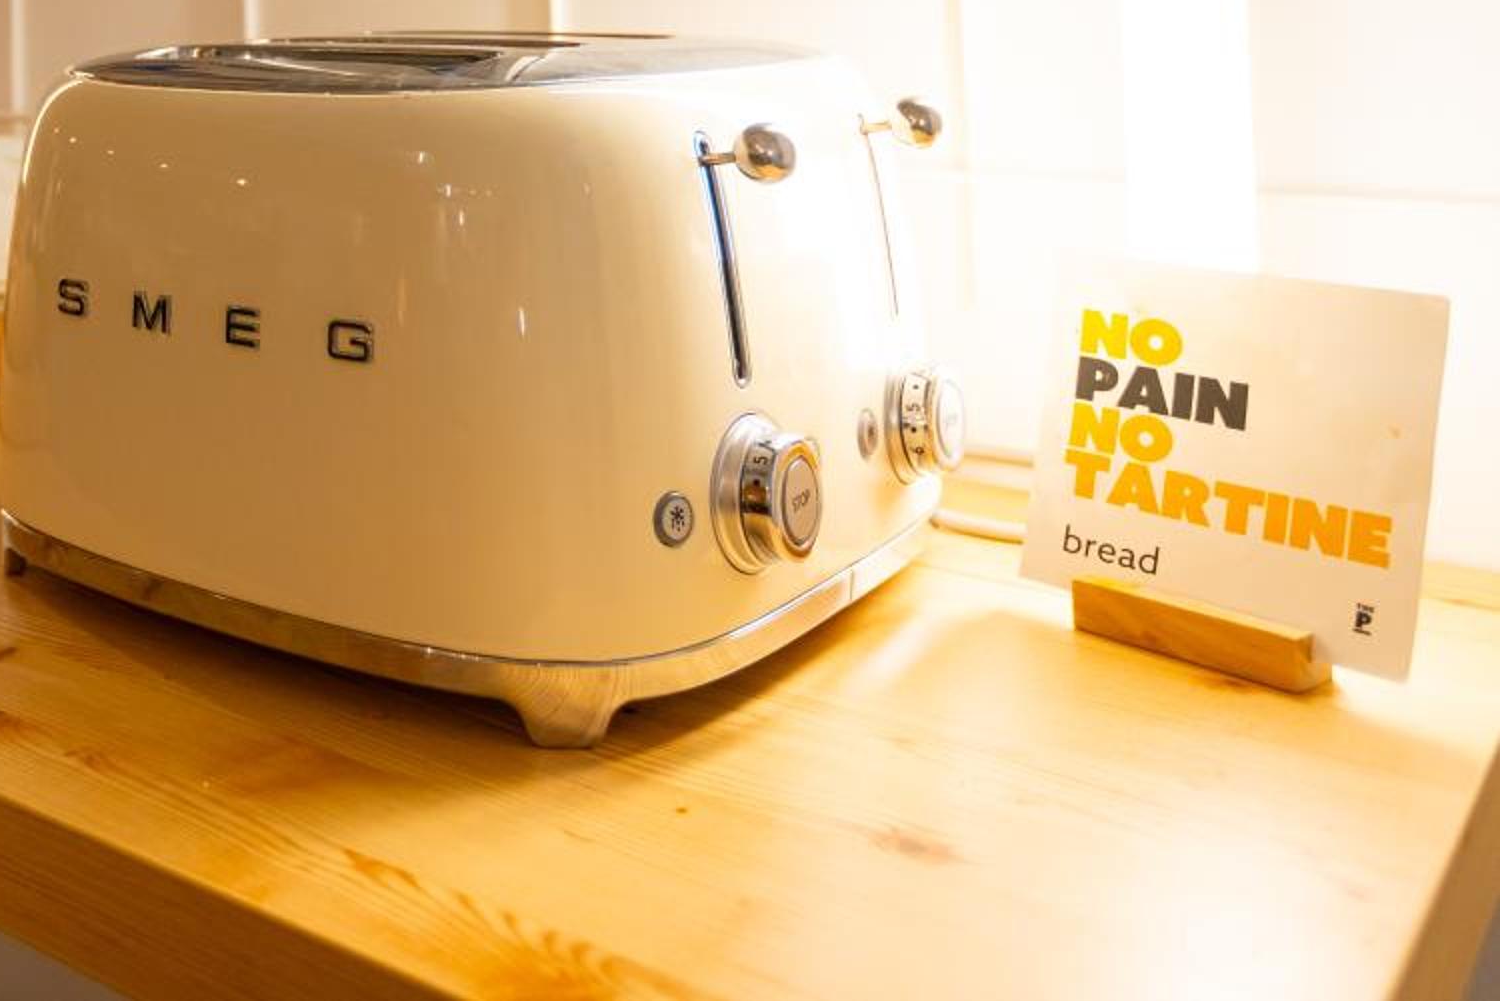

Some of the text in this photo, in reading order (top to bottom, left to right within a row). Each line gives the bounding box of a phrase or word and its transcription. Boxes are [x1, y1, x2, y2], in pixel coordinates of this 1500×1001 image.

[57, 278, 374, 364] SMEG
[1079, 308, 1184, 366] NO
[1075, 355, 1250, 431] PAIN
[1067, 402, 1174, 463] NO
[1065, 448, 1394, 570] TARTINE
[1062, 524, 1161, 576] bread
